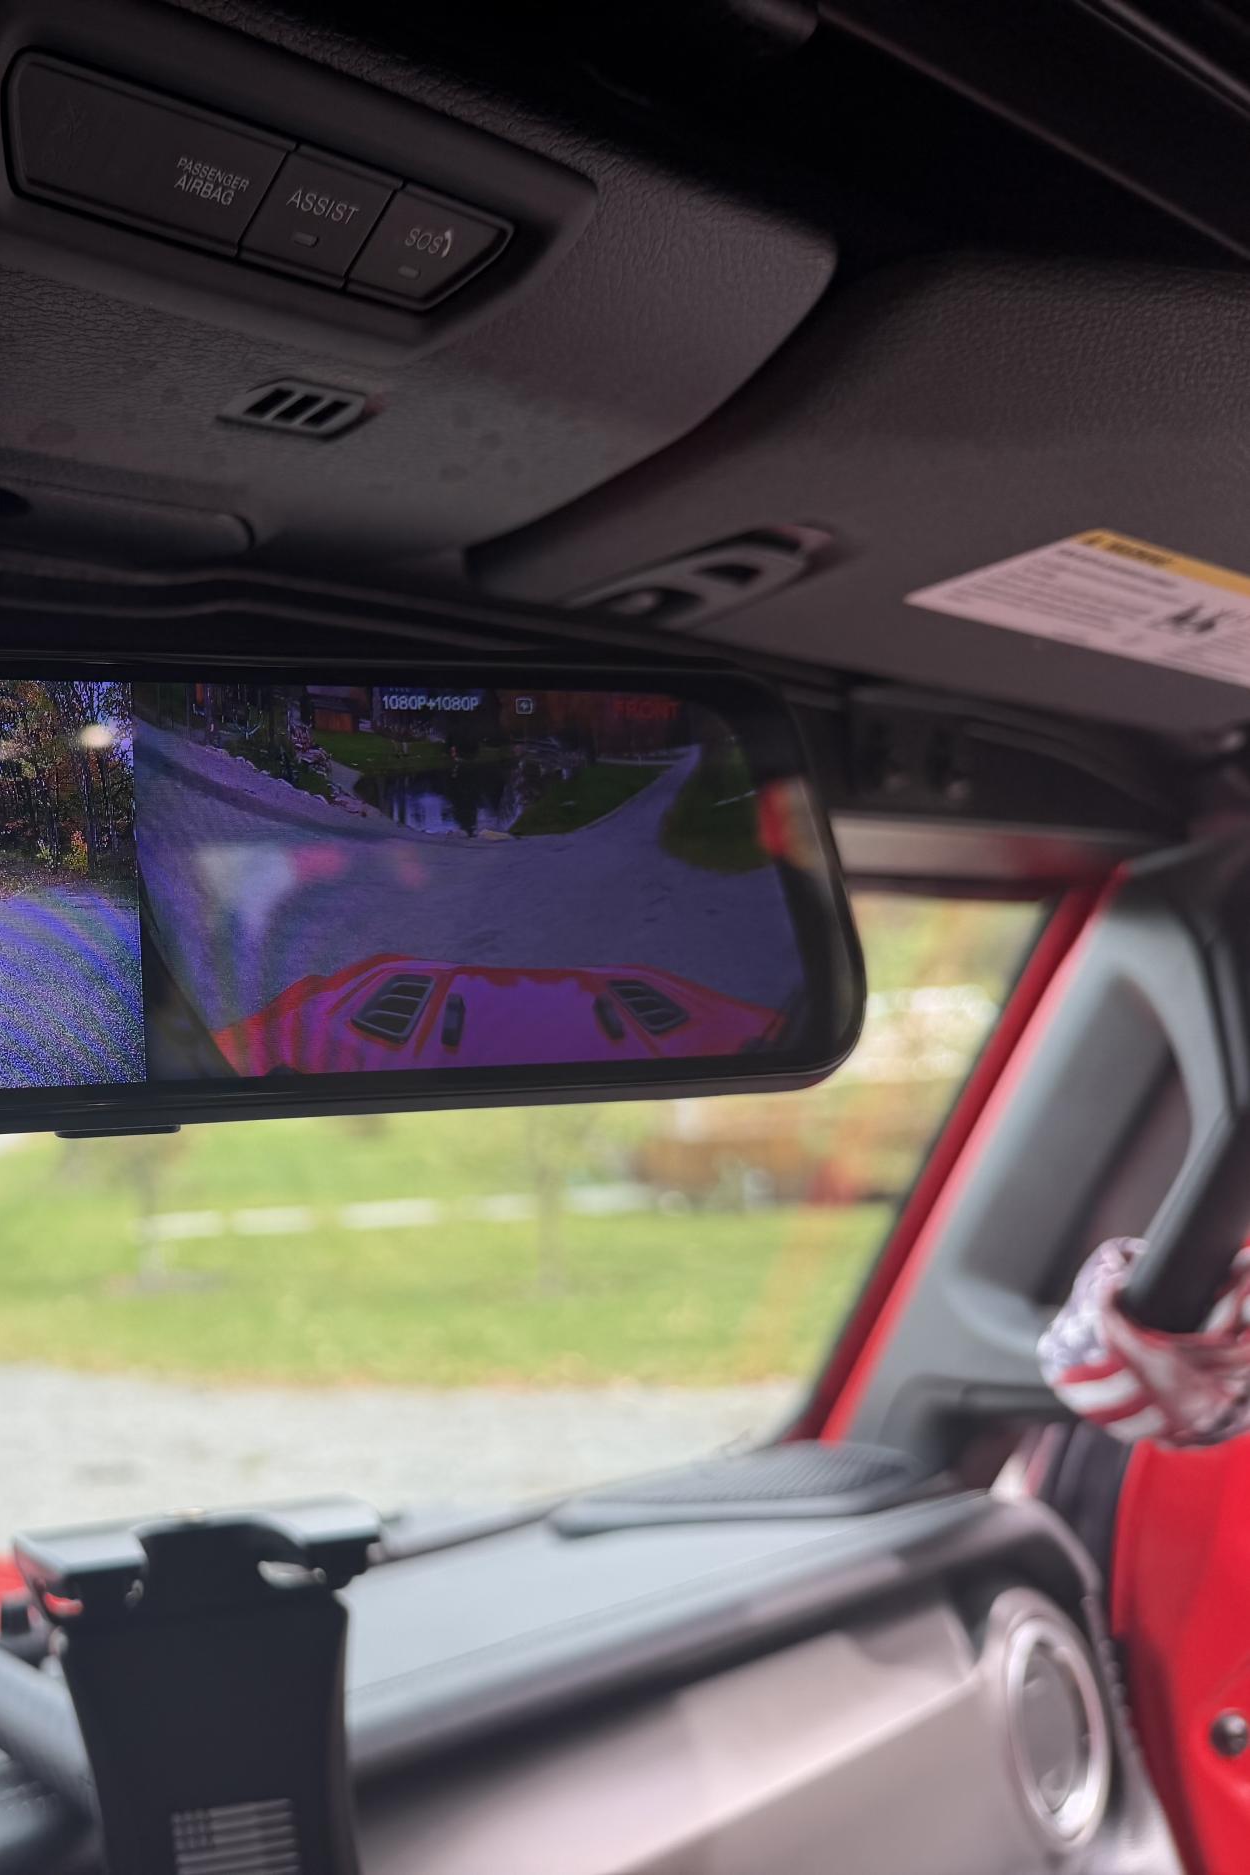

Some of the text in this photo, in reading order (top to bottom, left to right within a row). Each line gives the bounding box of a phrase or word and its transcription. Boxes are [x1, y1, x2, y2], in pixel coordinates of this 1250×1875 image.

[176, 156, 250, 193] PASSENGER
[173, 174, 235, 206] AIRBAG
[286, 188, 360, 225] ASSIST
[404, 227, 441, 255] SOS
[382, 694, 479, 711] 1080P+1080P
[613, 699, 681, 721] FRONT
